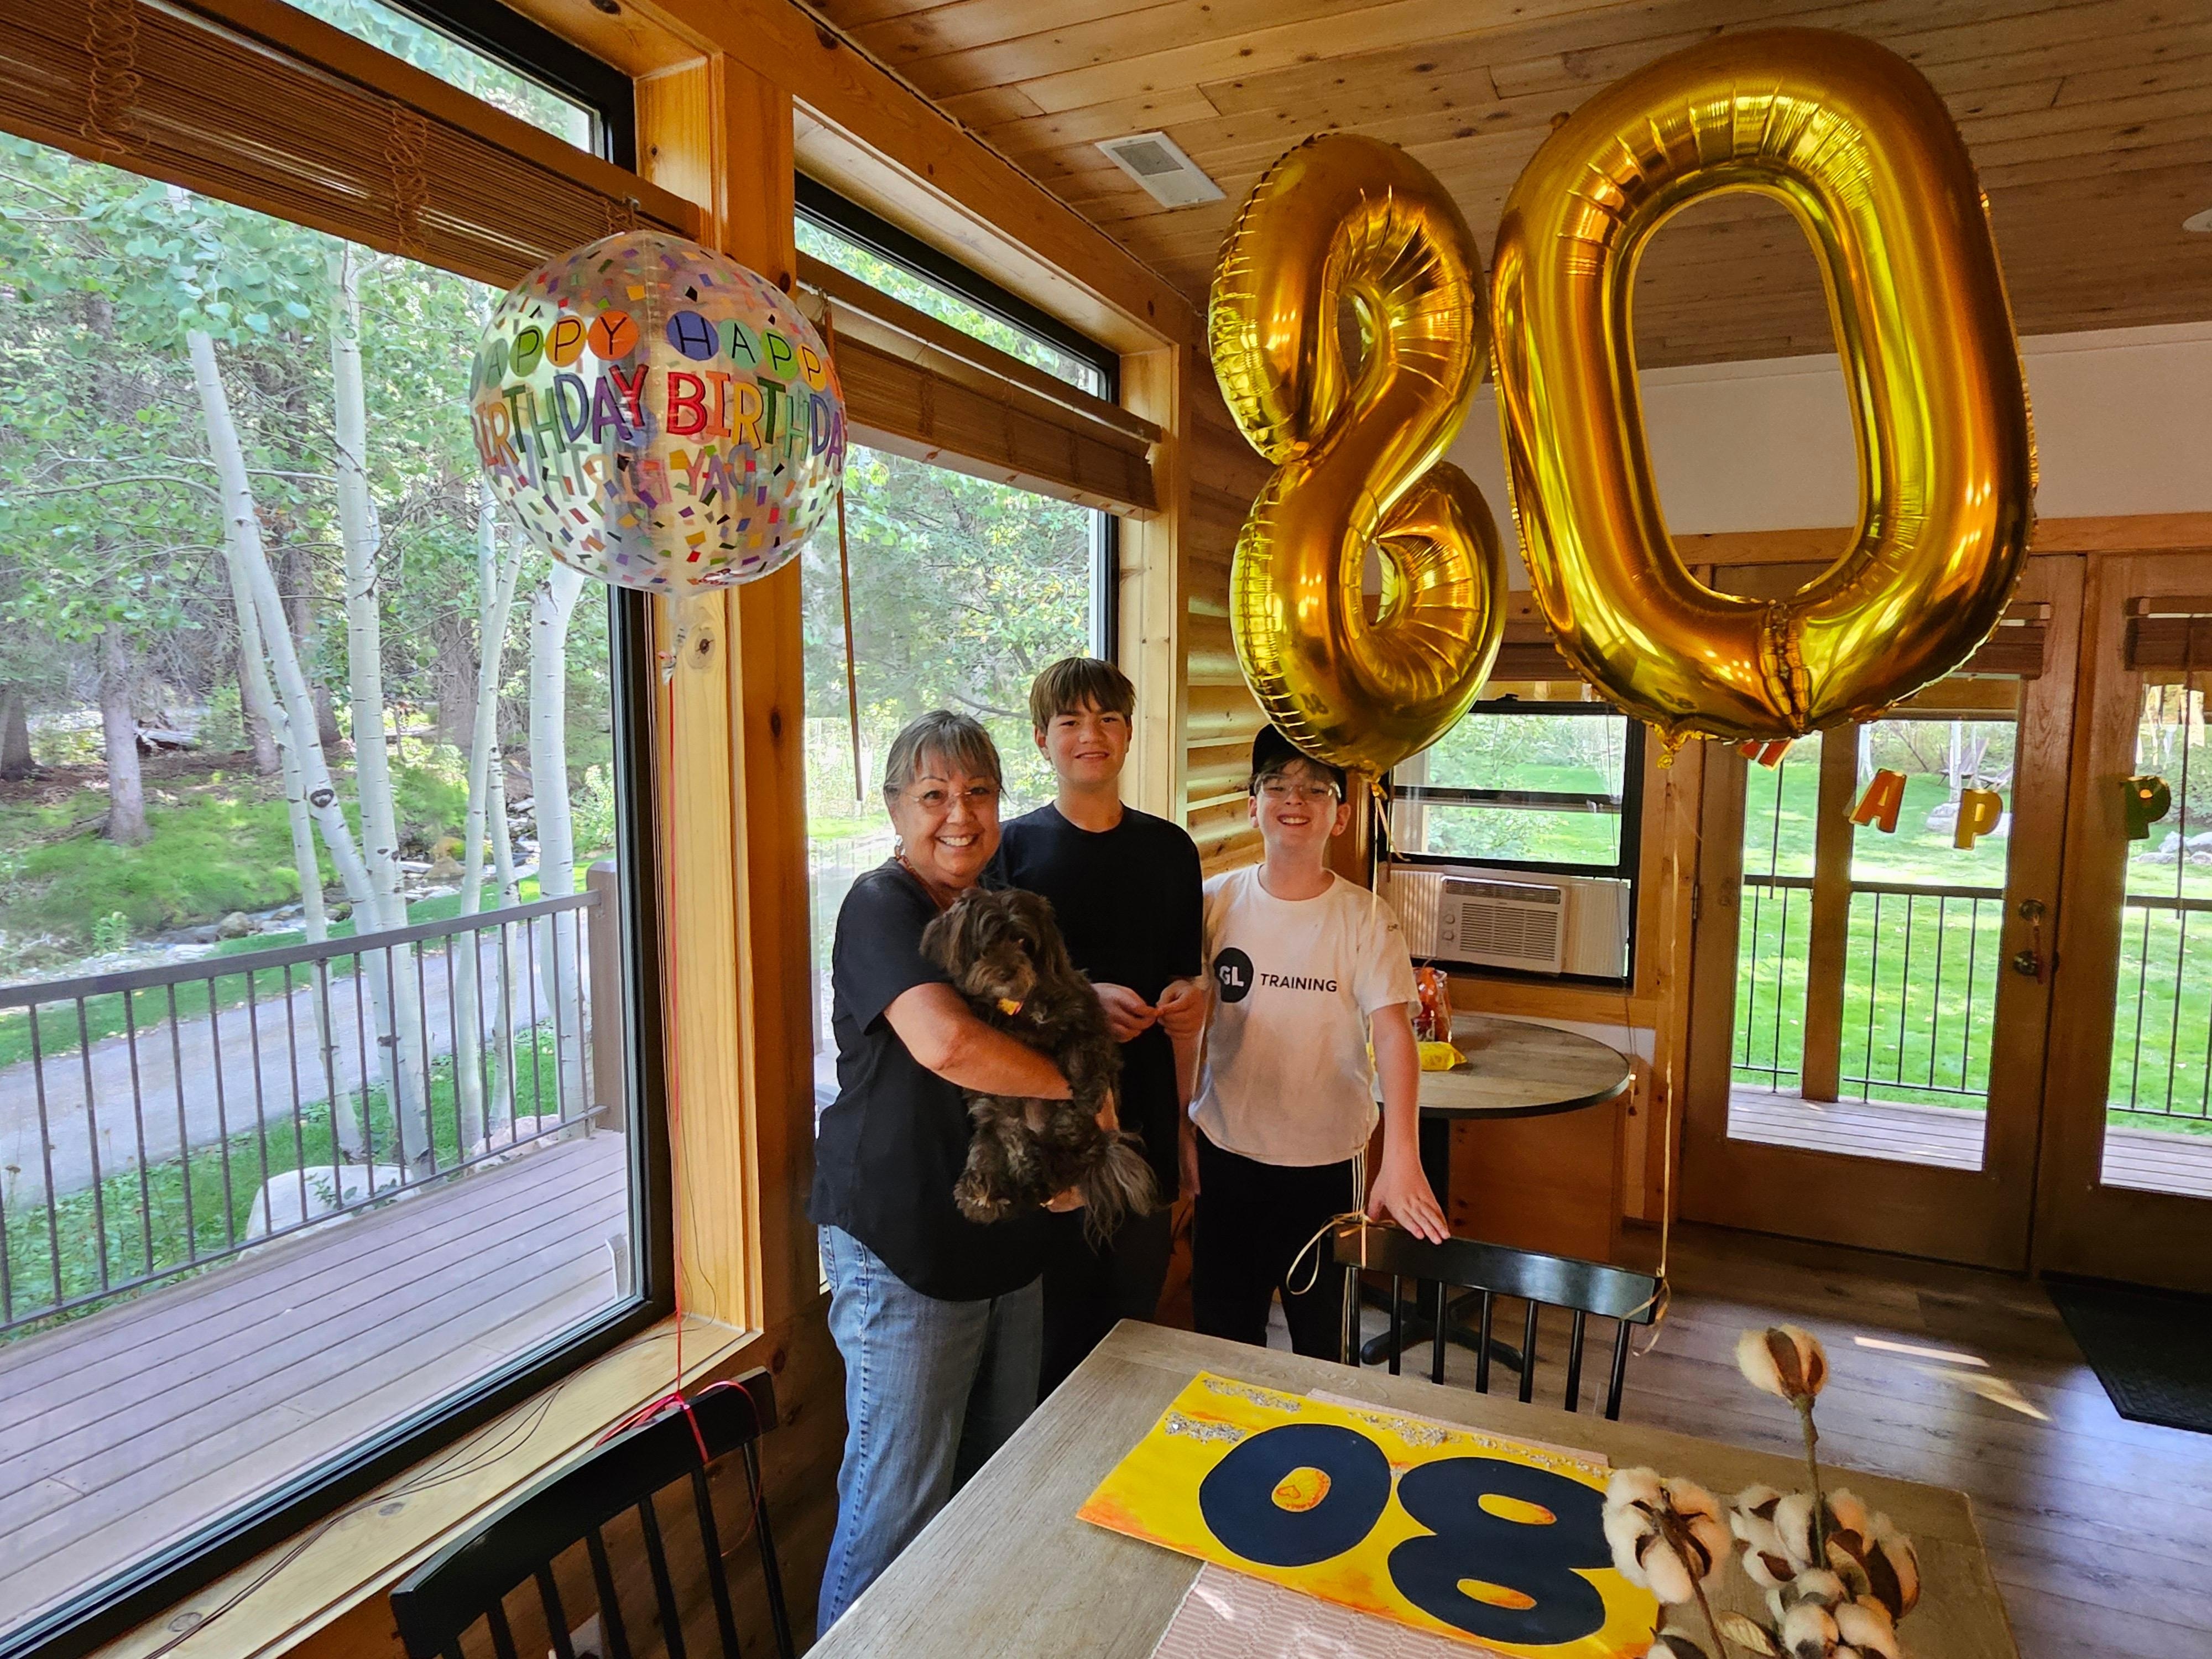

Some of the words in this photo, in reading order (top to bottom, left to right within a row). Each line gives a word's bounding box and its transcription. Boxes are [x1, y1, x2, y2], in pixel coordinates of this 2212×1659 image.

[479, 315, 630, 394] APPY
[1209, 28, 2041, 771] 80
[471, 364, 649, 467] IRTHDAY
[666, 370, 848, 472] BIRTHDA
[1219, 966, 1244, 987] GL
[1261, 973, 1338, 993] TRAINING
